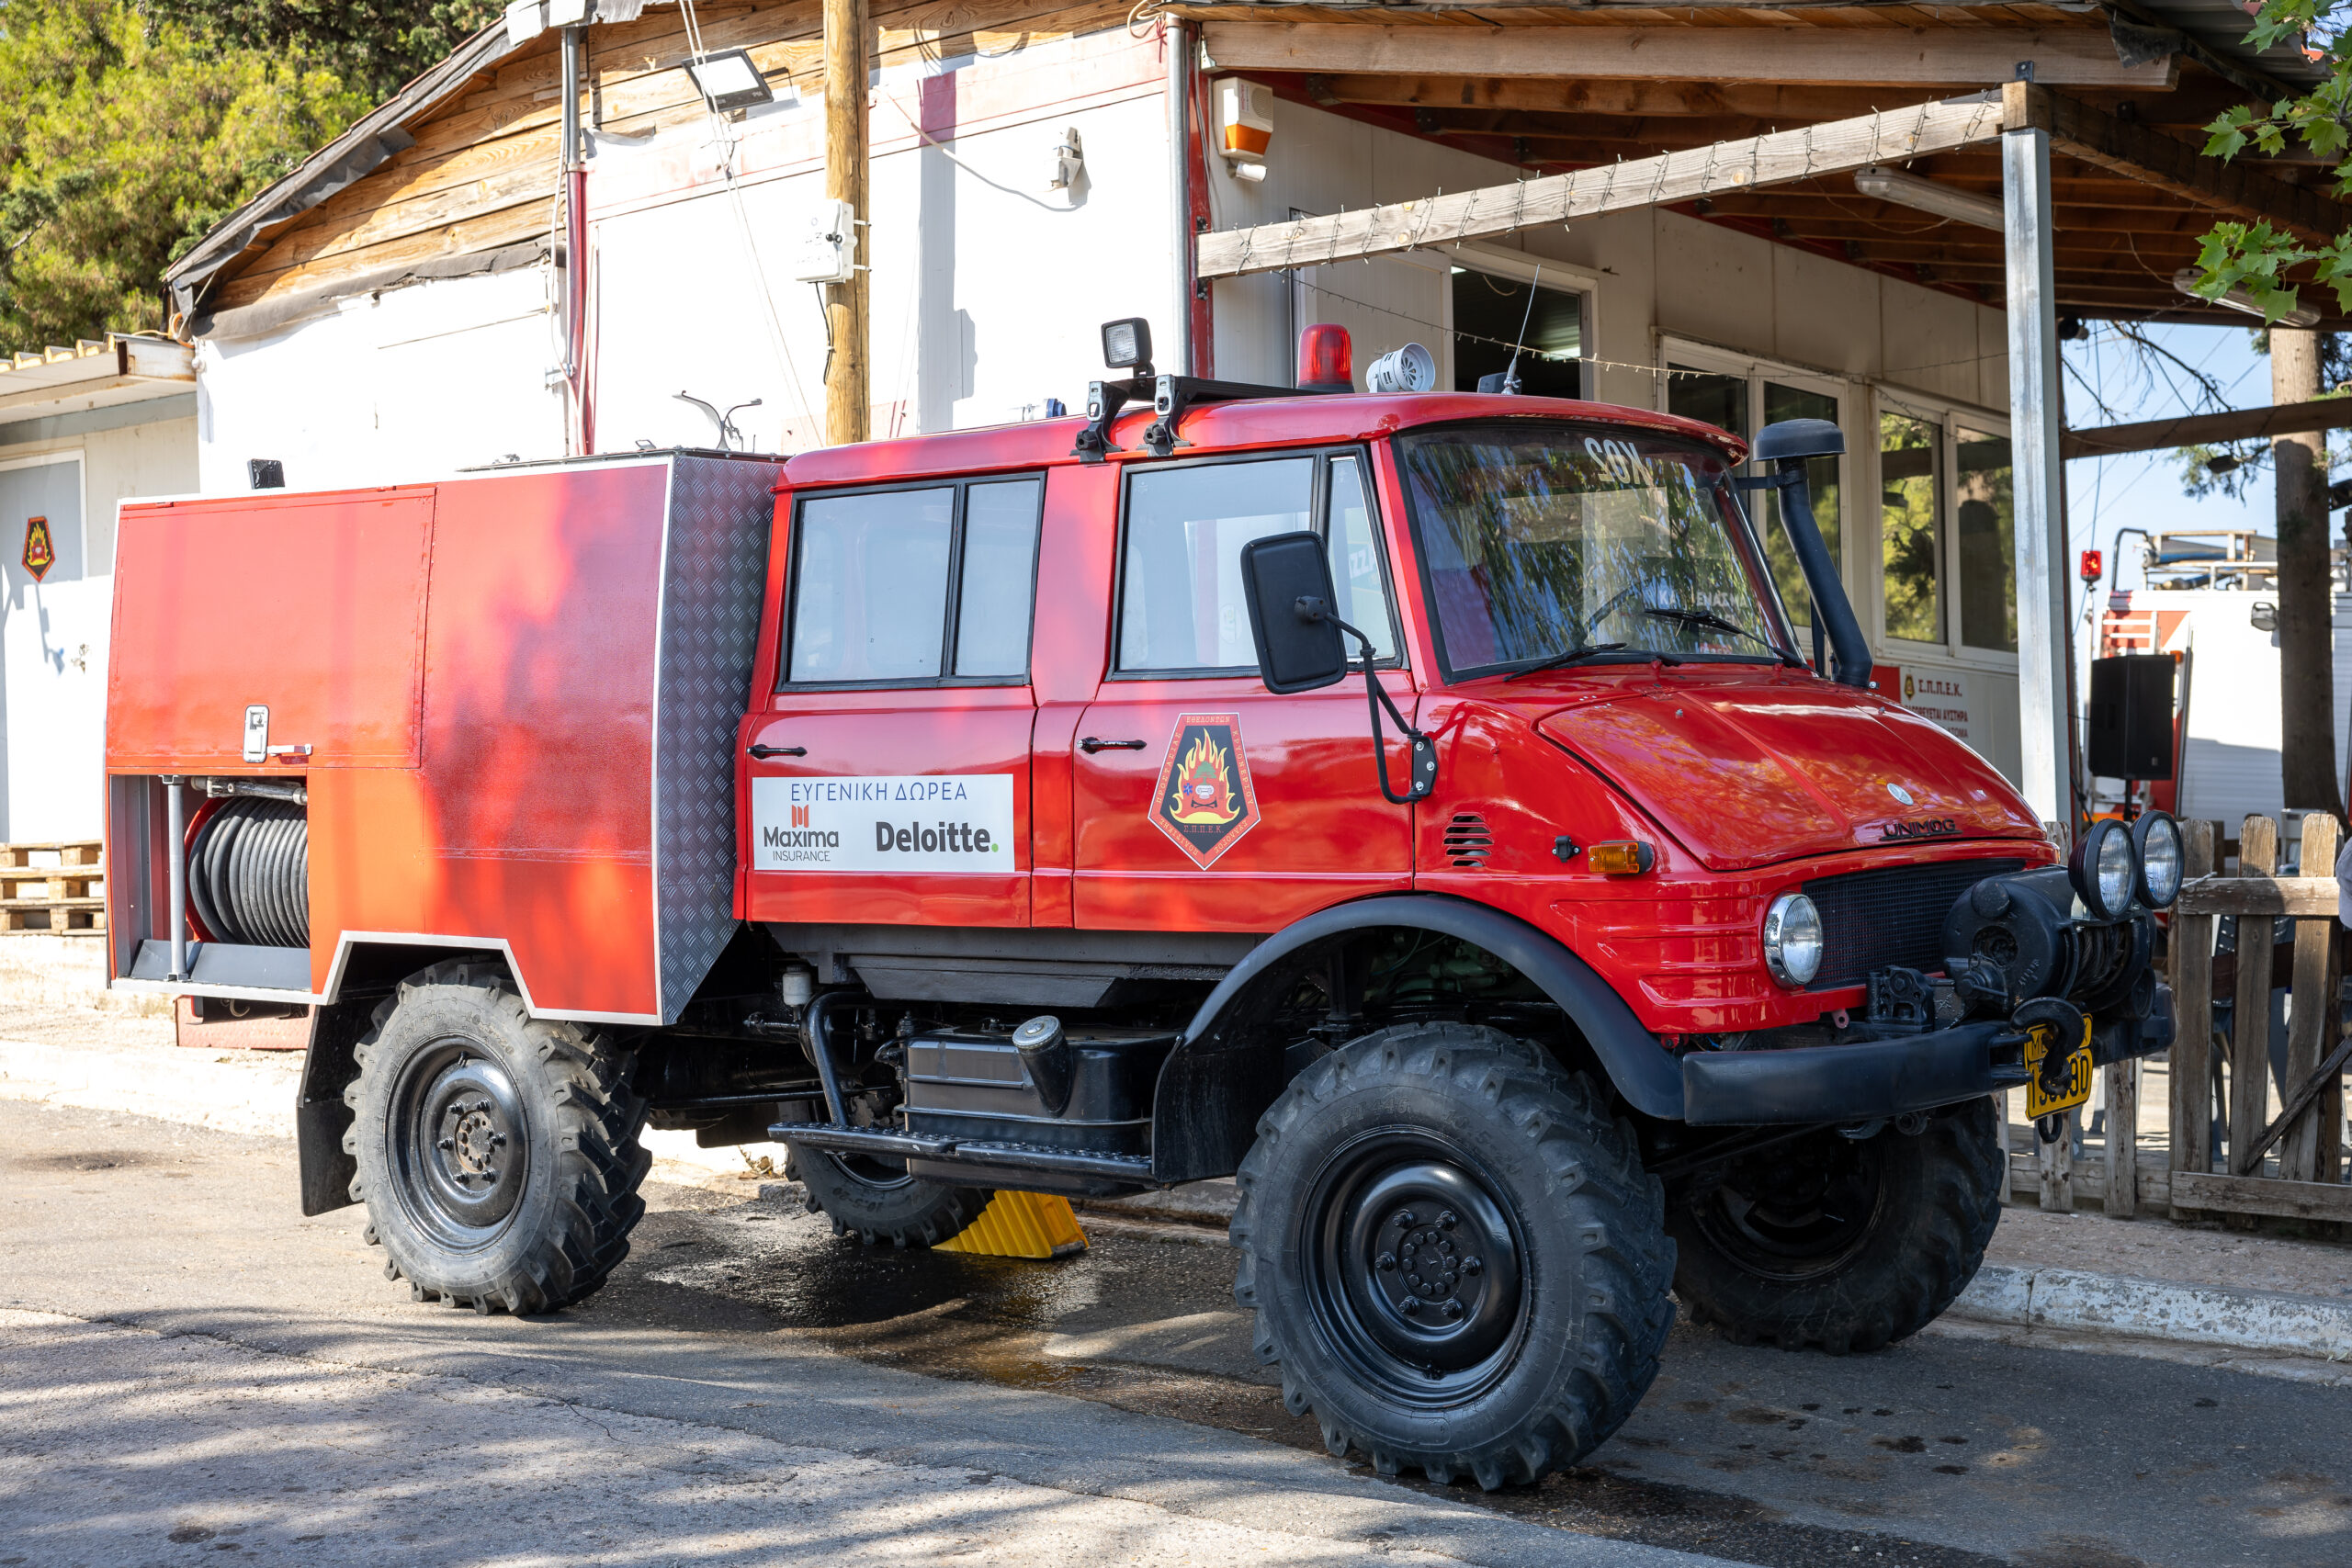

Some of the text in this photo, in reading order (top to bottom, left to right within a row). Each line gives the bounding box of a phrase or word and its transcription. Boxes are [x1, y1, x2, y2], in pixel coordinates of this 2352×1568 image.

[1918, 679, 1962, 696] Σ.Π.Π.Ε.Κ.
[791, 782, 967, 801] ΕΥΓΕΝΙΚΗ ΔΩΡΕΑ
[1183, 825, 1225, 833] Σ.Π.Π.Ε.Κ.
[1883, 818, 1956, 837] UNIMOG
[763, 827, 839, 848] Maxima
[773, 851, 831, 862] INSURANCE
